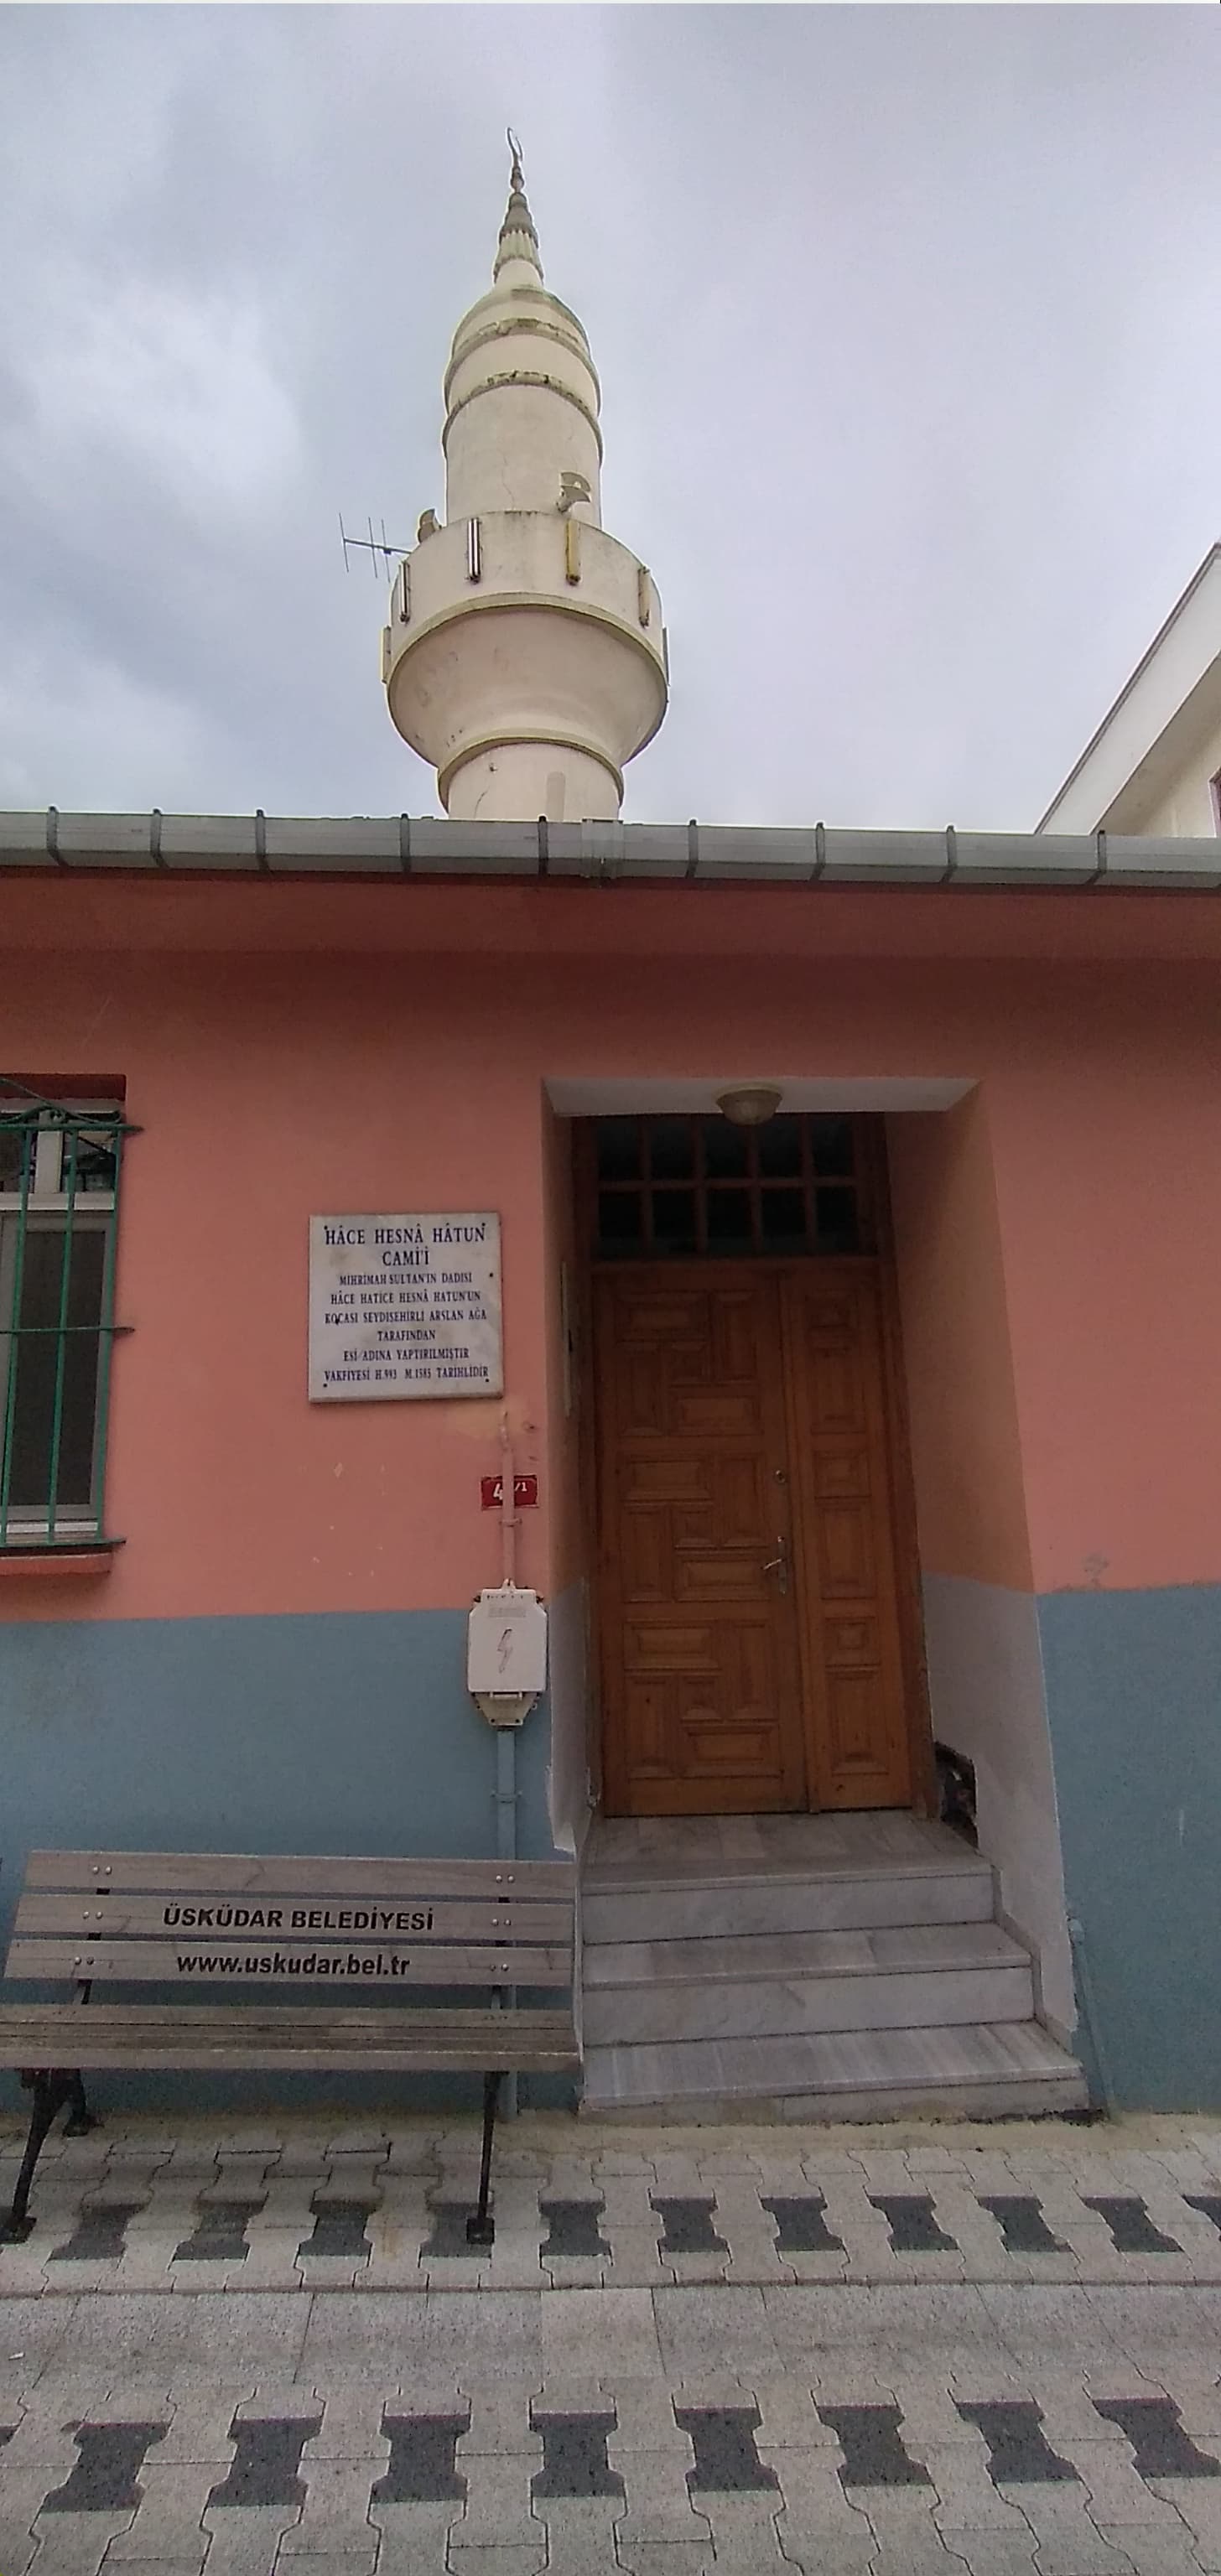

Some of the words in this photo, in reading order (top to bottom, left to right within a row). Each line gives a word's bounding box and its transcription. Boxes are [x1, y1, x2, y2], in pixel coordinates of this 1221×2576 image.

[325, 1224, 366, 1245] HÂCE
[375, 1223, 423, 1244] HESNÂ
[433, 1222, 486, 1243] HÂTUN
[330, 1291, 355, 1305] HÂCE
[361, 1291, 394, 1304] HATİCE
[399, 1289, 429, 1303] HESNÂ
[429, 1309, 465, 1322] ARSLAN
[468, 1306, 487, 1320] AĞA
[377, 1329, 436, 1342] TARAFINDAN
[362, 1349, 392, 1361] ADINA
[163, 1903, 283, 1928] ÜSKÜDAR
[291, 1906, 434, 1930] BELEDİYESİ
[176, 1952, 411, 1976] www.uskudar.bel.tr
